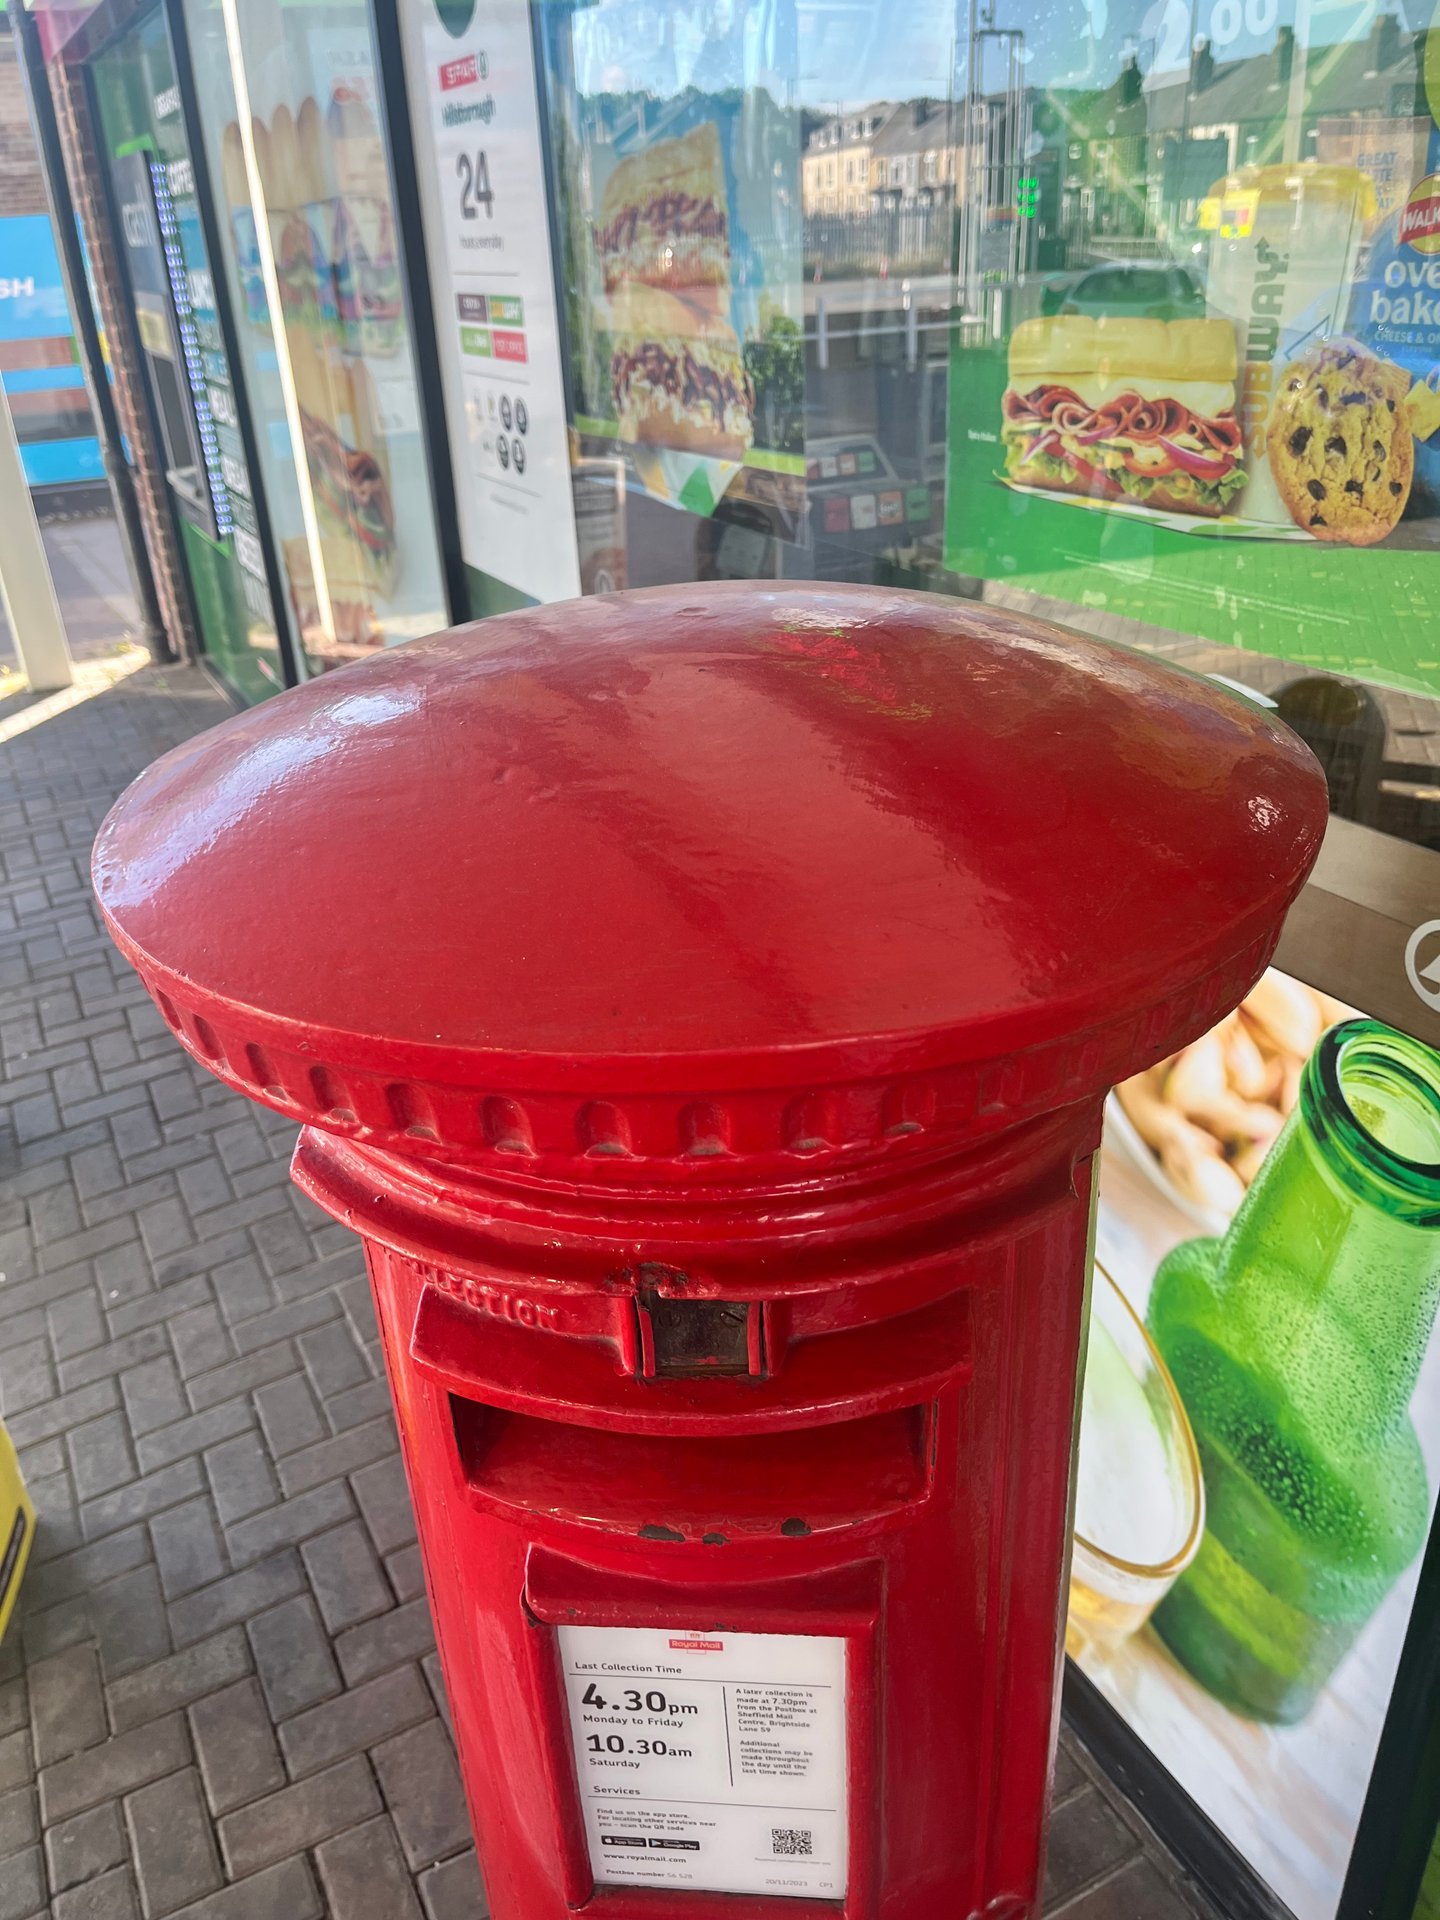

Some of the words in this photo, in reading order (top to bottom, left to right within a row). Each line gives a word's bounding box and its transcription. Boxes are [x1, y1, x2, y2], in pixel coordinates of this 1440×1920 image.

[456, 151, 495, 219] 24
[1244, 236, 1289, 461] SUBWAY
[671, 1639, 698, 1649] Royal
[699, 1641, 721, 1650] Mail
[575, 1661, 598, 1670] Last
[601, 1662, 653, 1673] Collection
[655, 1665, 682, 1674] Time
[581, 1683, 698, 1716] 4.30pm
[771, 1698, 808, 1706] 7.30pm
[583, 1715, 628, 1726] Monday
[632, 1717, 643, 1725] to
[648, 1717, 683, 1728] Friday
[769, 1720, 810, 1728] Brightside
[586, 1734, 692, 1757] 10.30am
[740, 1740, 780, 1748] Additional
[589, 1758, 640, 1769] Saturday
[765, 1756, 810, 1764] throughout
[593, 1786, 640, 1795] Services
[604, 1853, 687, 1863] www.royalmail.com
[606, 1868, 634, 1876] Postbox
